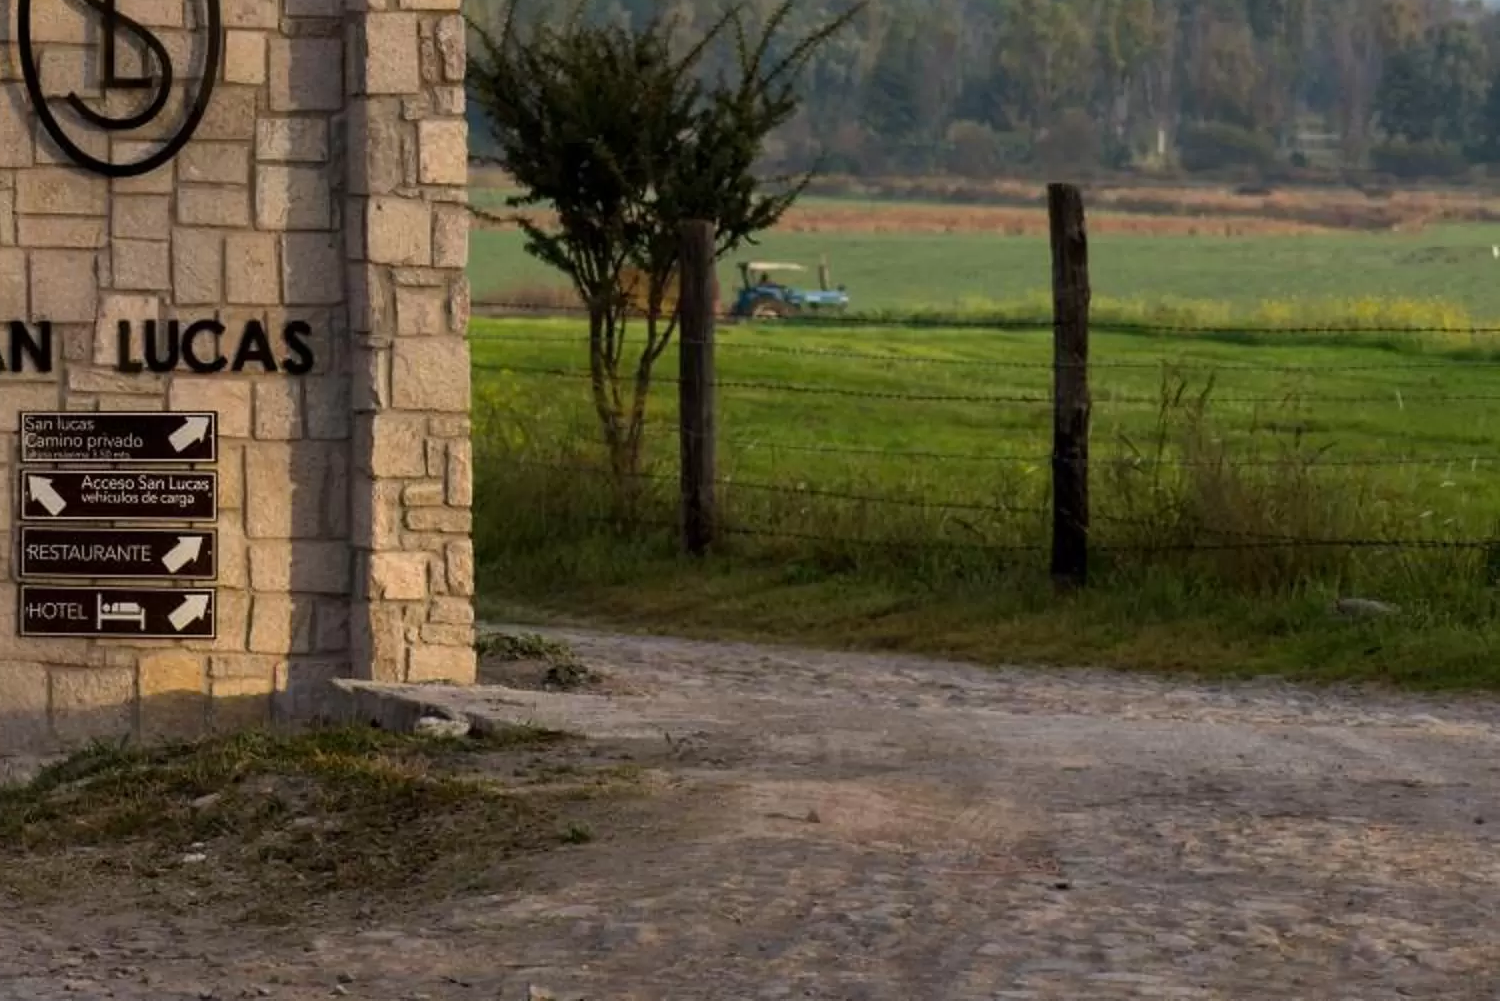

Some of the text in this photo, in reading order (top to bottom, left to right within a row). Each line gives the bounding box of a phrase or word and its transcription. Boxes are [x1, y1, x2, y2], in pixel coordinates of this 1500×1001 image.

[117, 318, 314, 375] LUCAS
[25, 416, 53, 431] San
[26, 432, 144, 451] Camino privado
[81, 474, 210, 490] Acceso San Lucas
[141, 490, 158, 504] de
[160, 493, 195, 507] carga
[28, 544, 152, 561] RESTAURANTE
[29, 602, 89, 619] HOTEL
